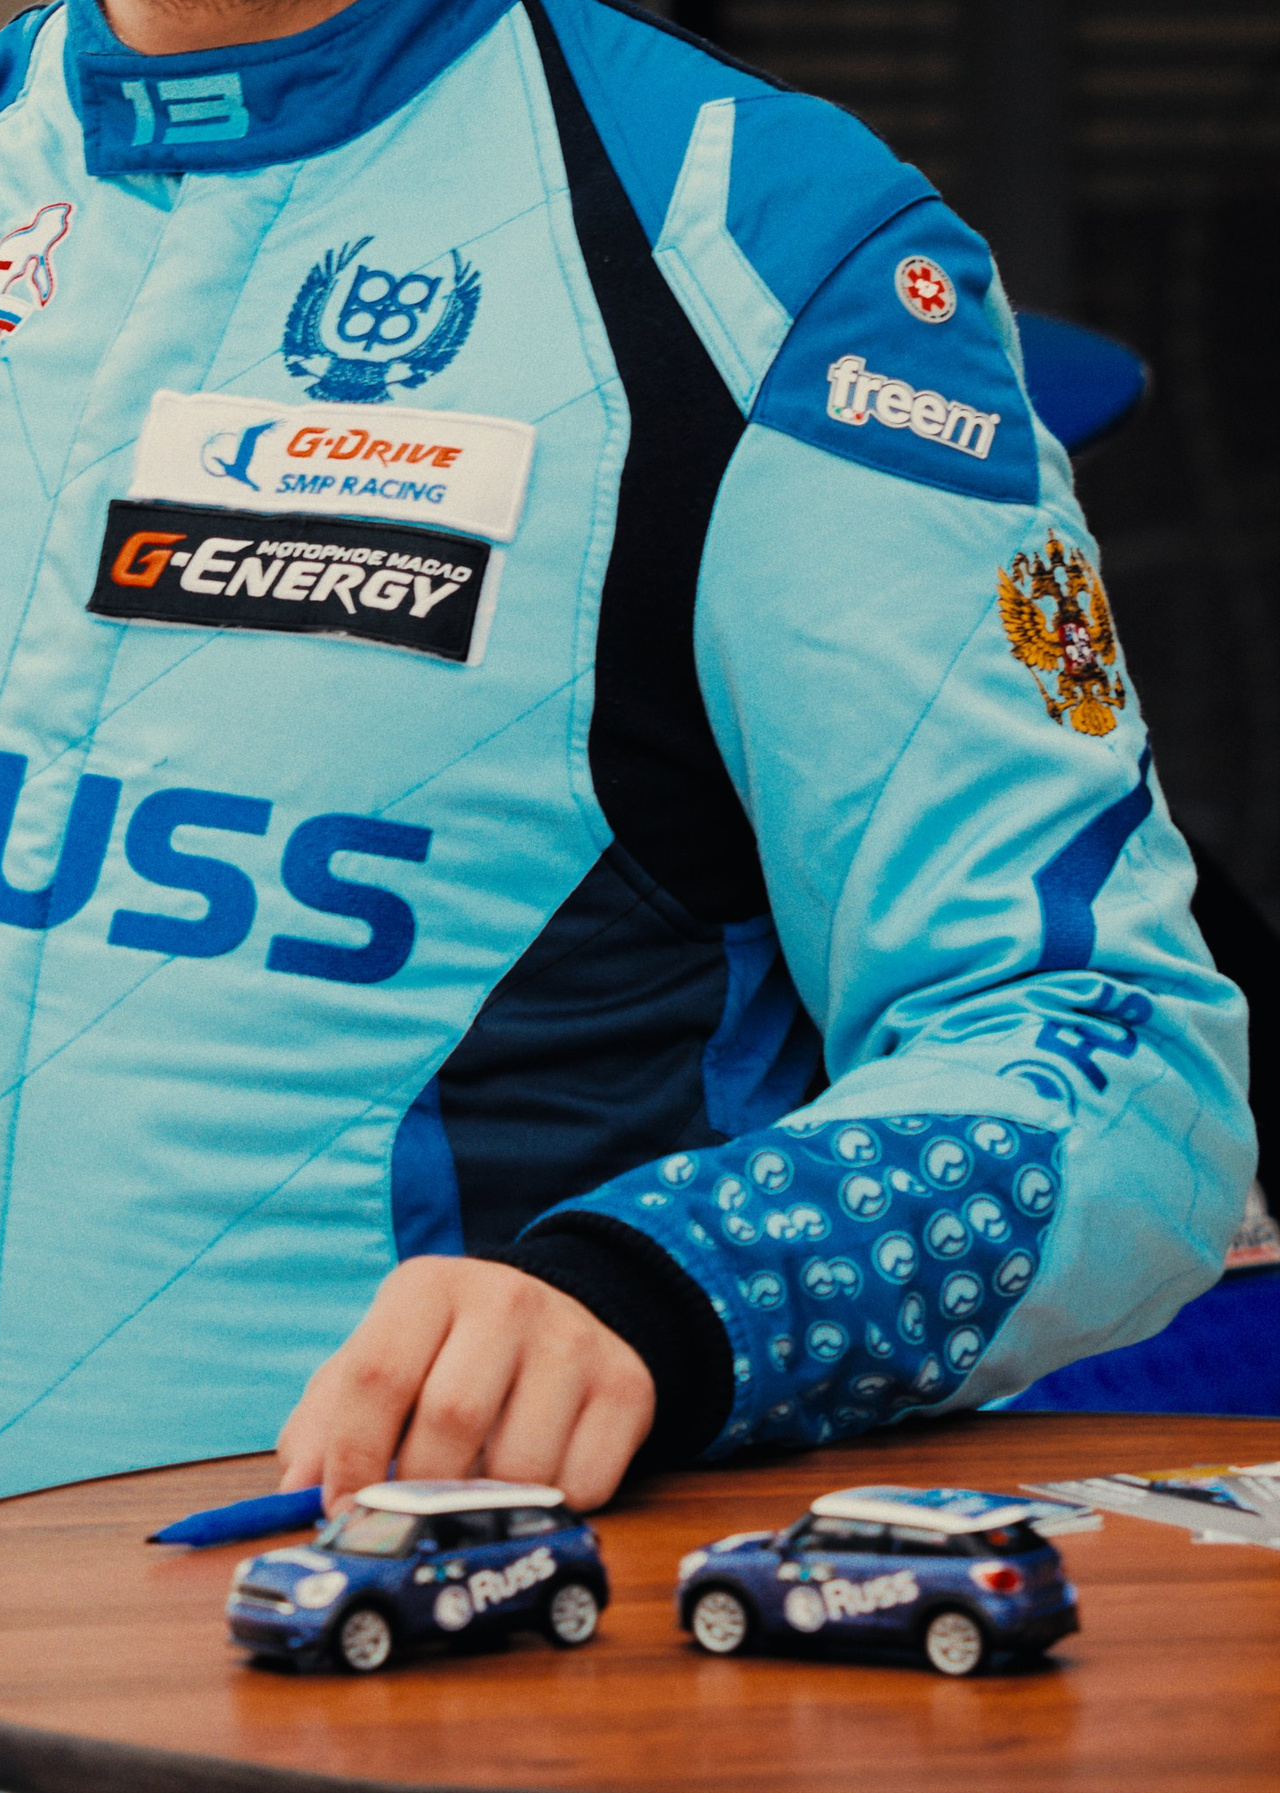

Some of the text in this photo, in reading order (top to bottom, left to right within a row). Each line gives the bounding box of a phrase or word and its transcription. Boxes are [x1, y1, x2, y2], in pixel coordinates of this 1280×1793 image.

[121, 72, 249, 146] 13
[830, 356, 994, 457] freem
[276, 474, 448, 504] SMP RACING
[255, 540, 473, 583] МОТОРНОЕ МАСЛО
